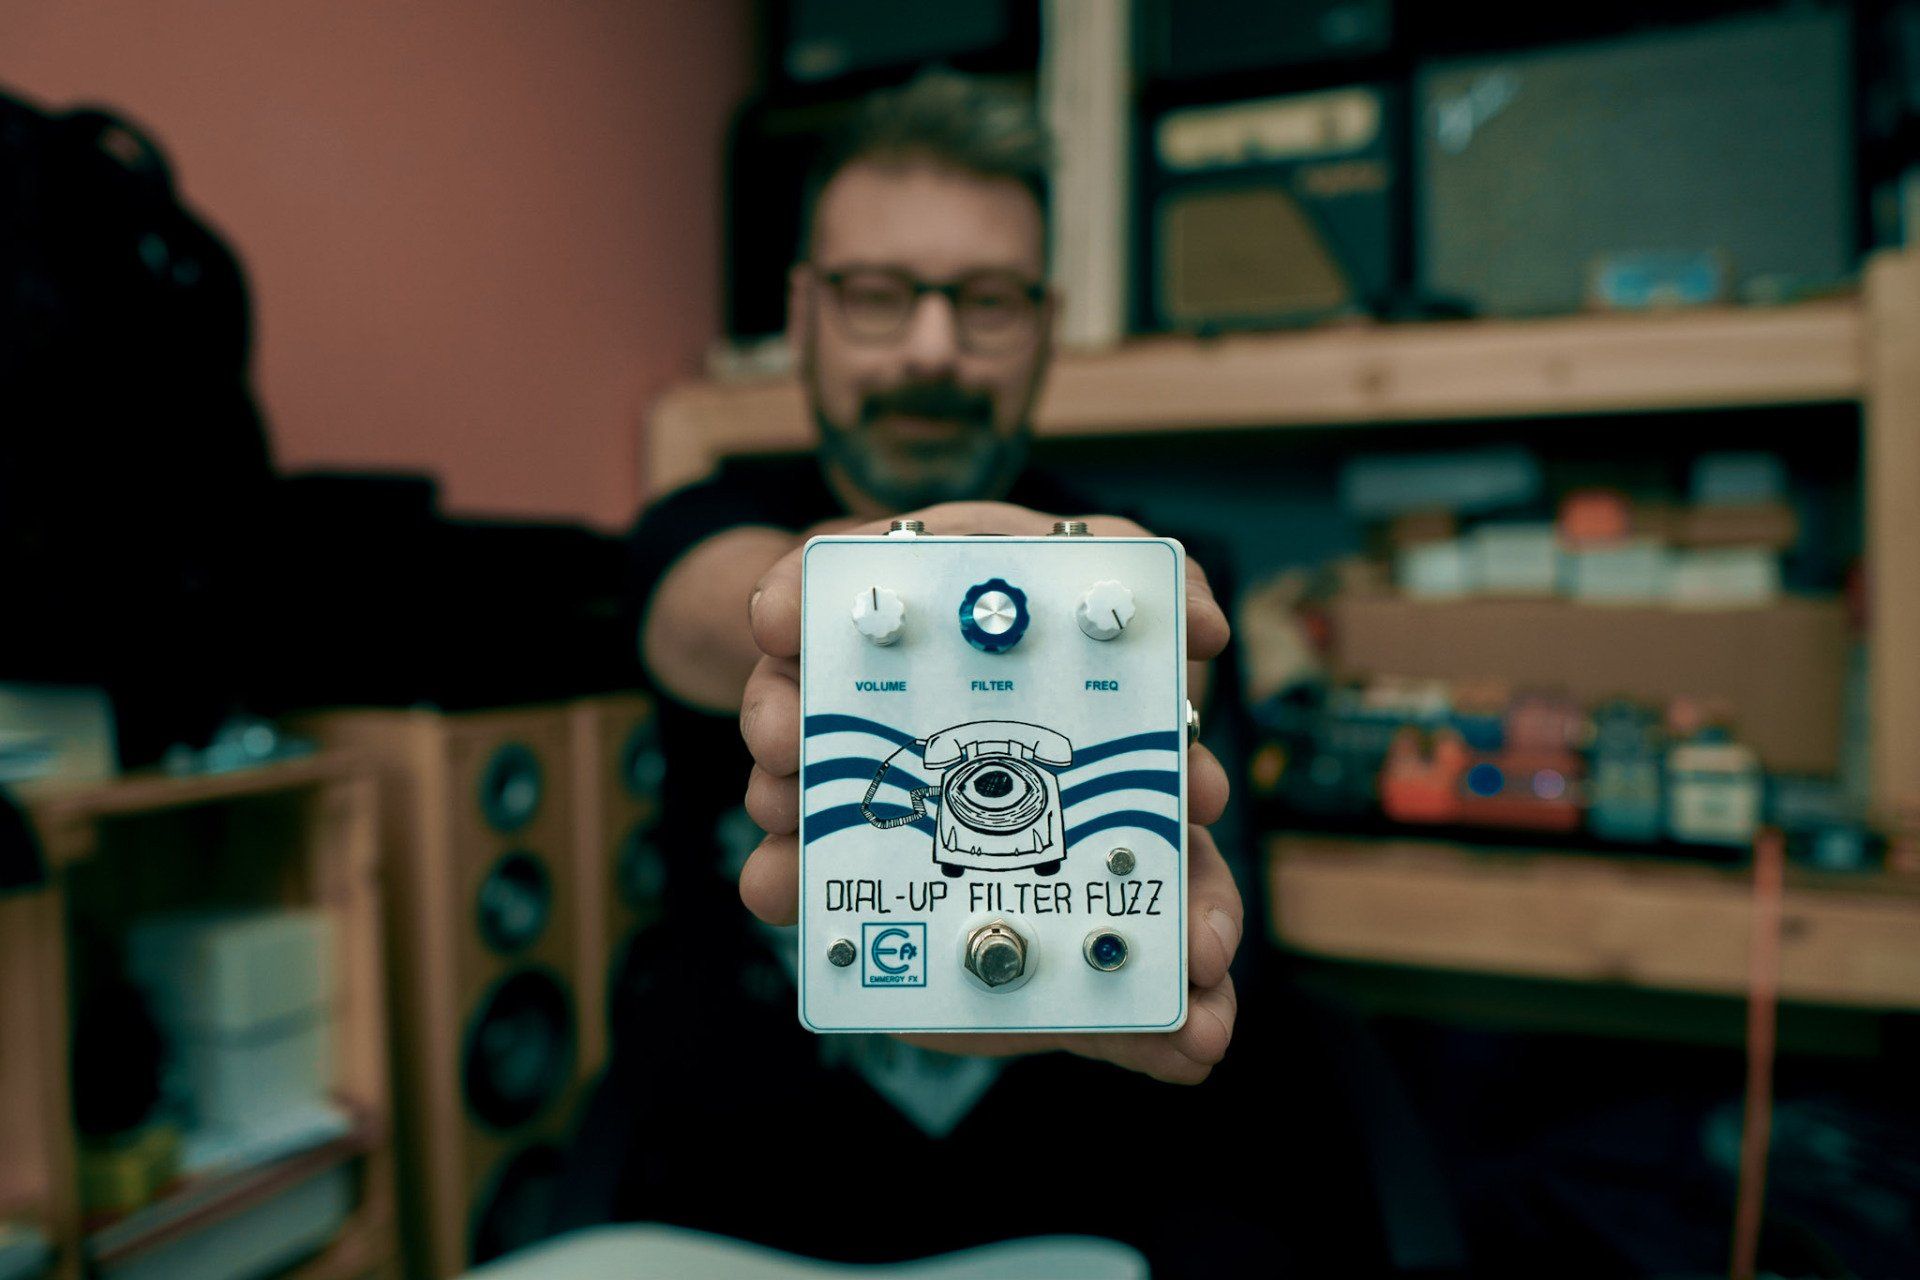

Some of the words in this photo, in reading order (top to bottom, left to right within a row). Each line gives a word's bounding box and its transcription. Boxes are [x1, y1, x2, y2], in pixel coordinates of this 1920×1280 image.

[855, 680, 907, 692] VOLUME
[971, 680, 1014, 692] FILTER
[1085, 680, 1119, 692] FREQ
[826, 879, 948, 914] DIAL-UP
[969, 882, 1072, 914] FILTER
[1086, 881, 1163, 916] FUZZ
[869, 975, 905, 983] EMMERGY
[908, 975, 918, 983] FX
